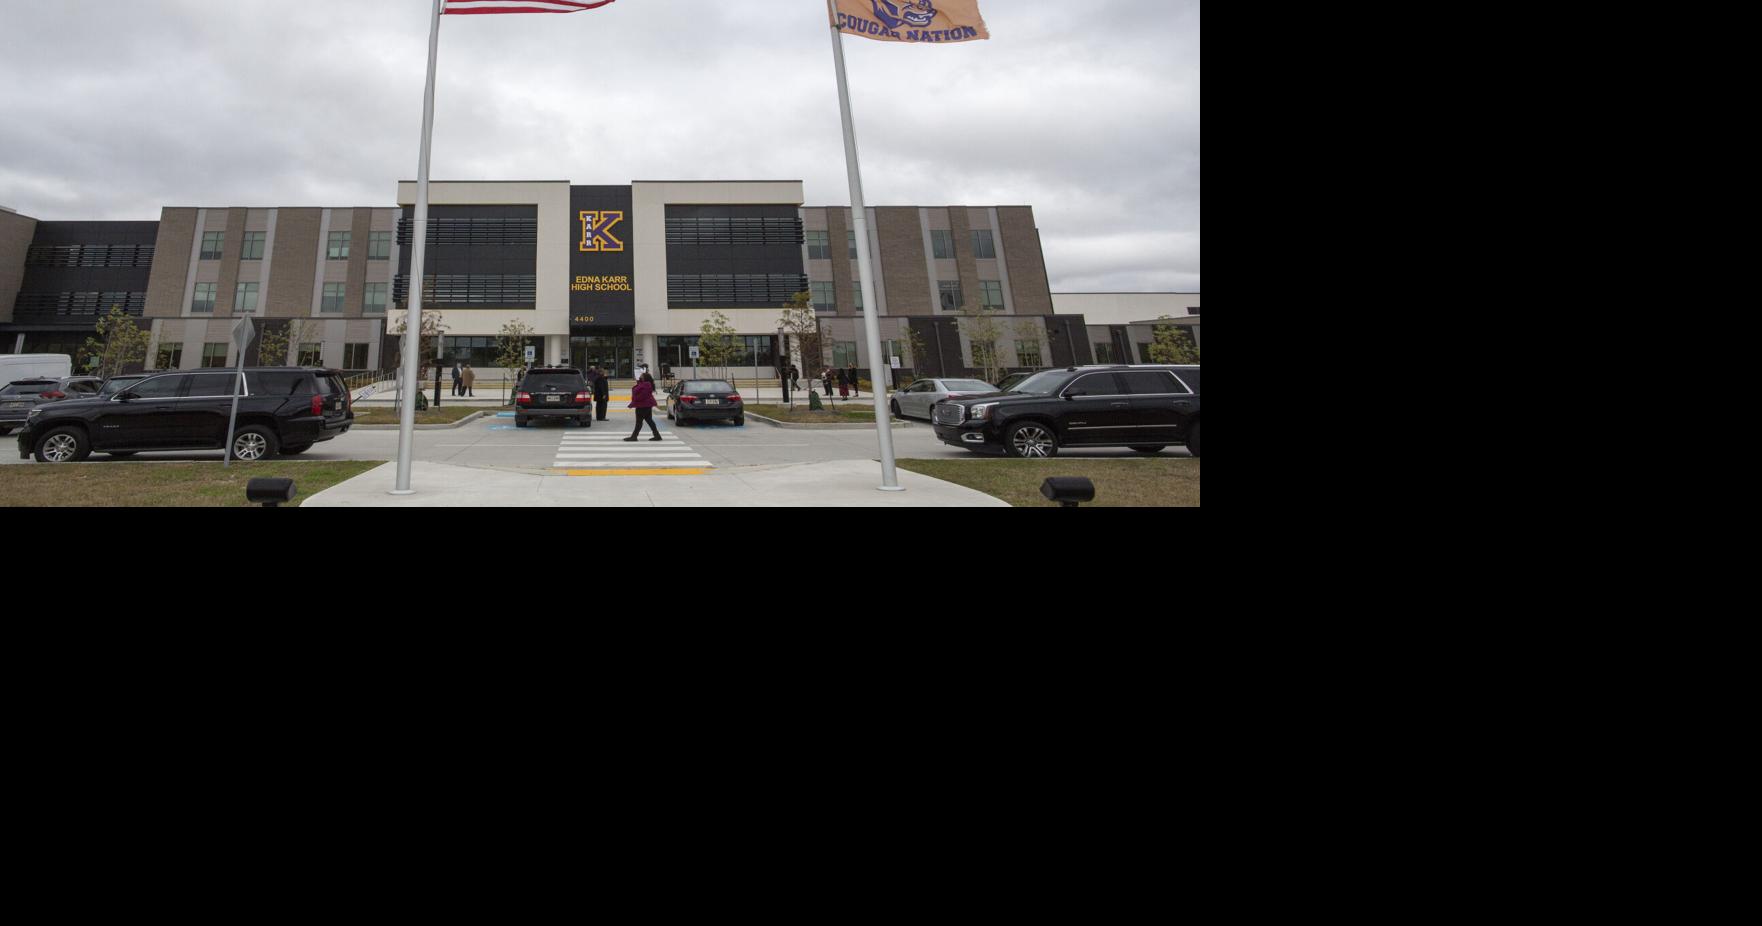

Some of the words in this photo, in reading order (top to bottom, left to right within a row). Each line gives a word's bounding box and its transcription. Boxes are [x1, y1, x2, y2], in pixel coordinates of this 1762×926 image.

[906, 25, 977, 42] NATION
[580, 211, 623, 251] K
[595, 283, 632, 291] SCHOOL
